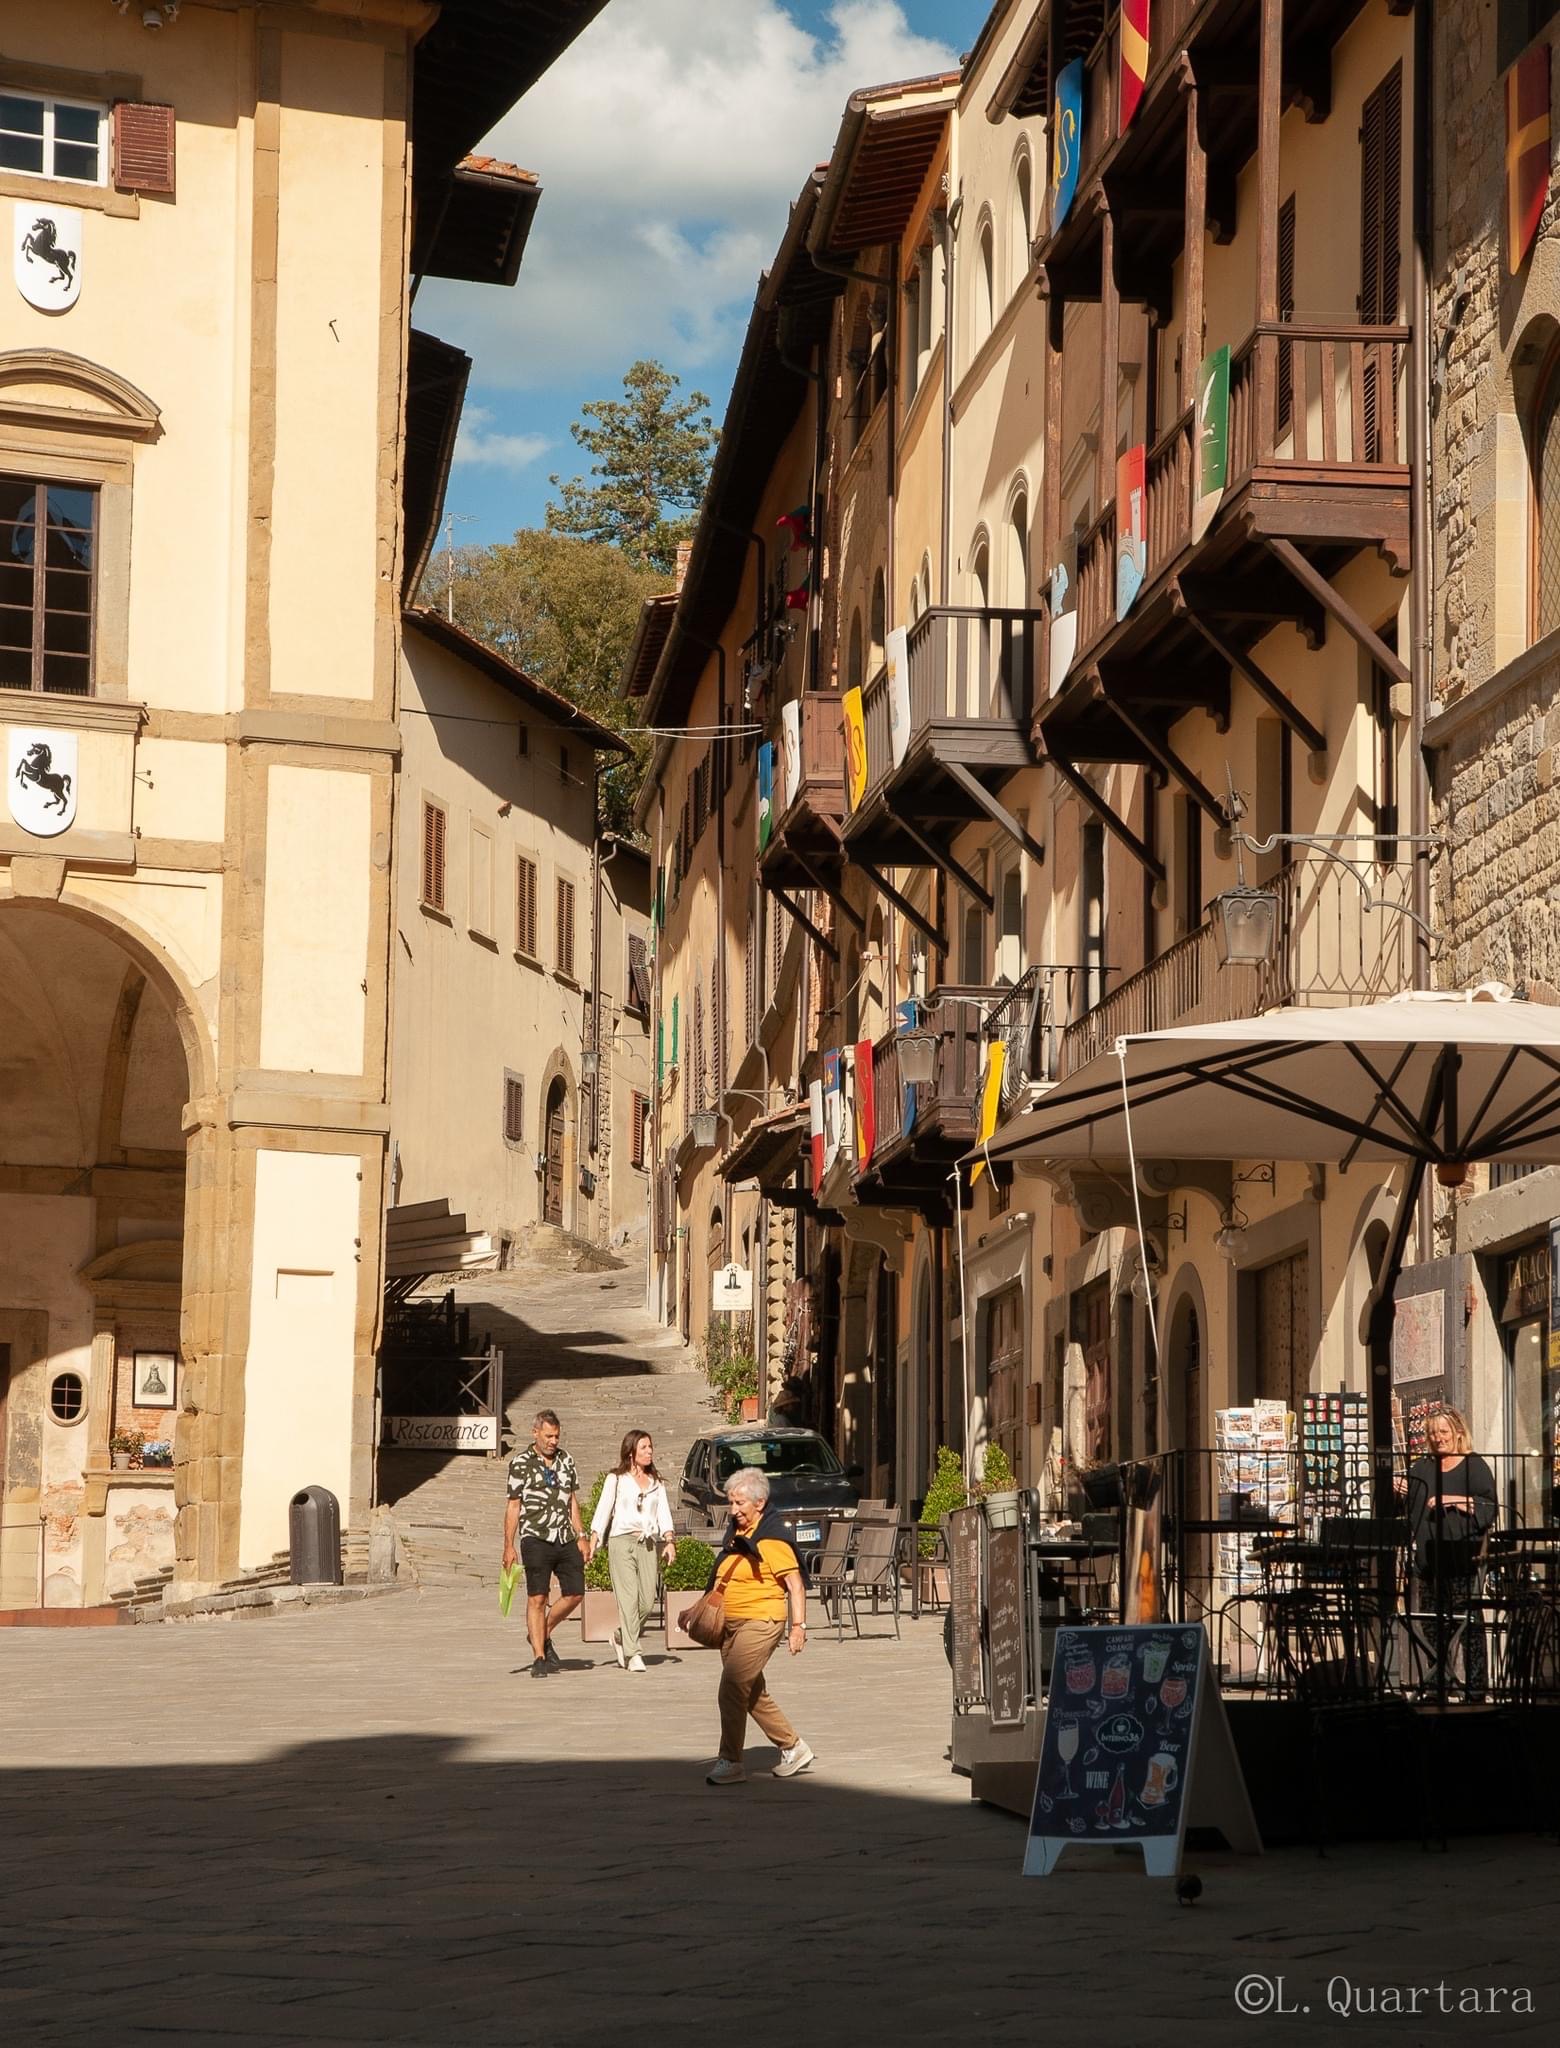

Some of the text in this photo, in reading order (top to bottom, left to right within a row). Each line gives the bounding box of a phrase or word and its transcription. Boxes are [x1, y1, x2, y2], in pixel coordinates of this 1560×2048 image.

[1105, 1643, 1134, 1653] ORANGE
[1159, 1740, 1181, 1752] Beer
[1086, 1771, 1110, 1789] WINE
